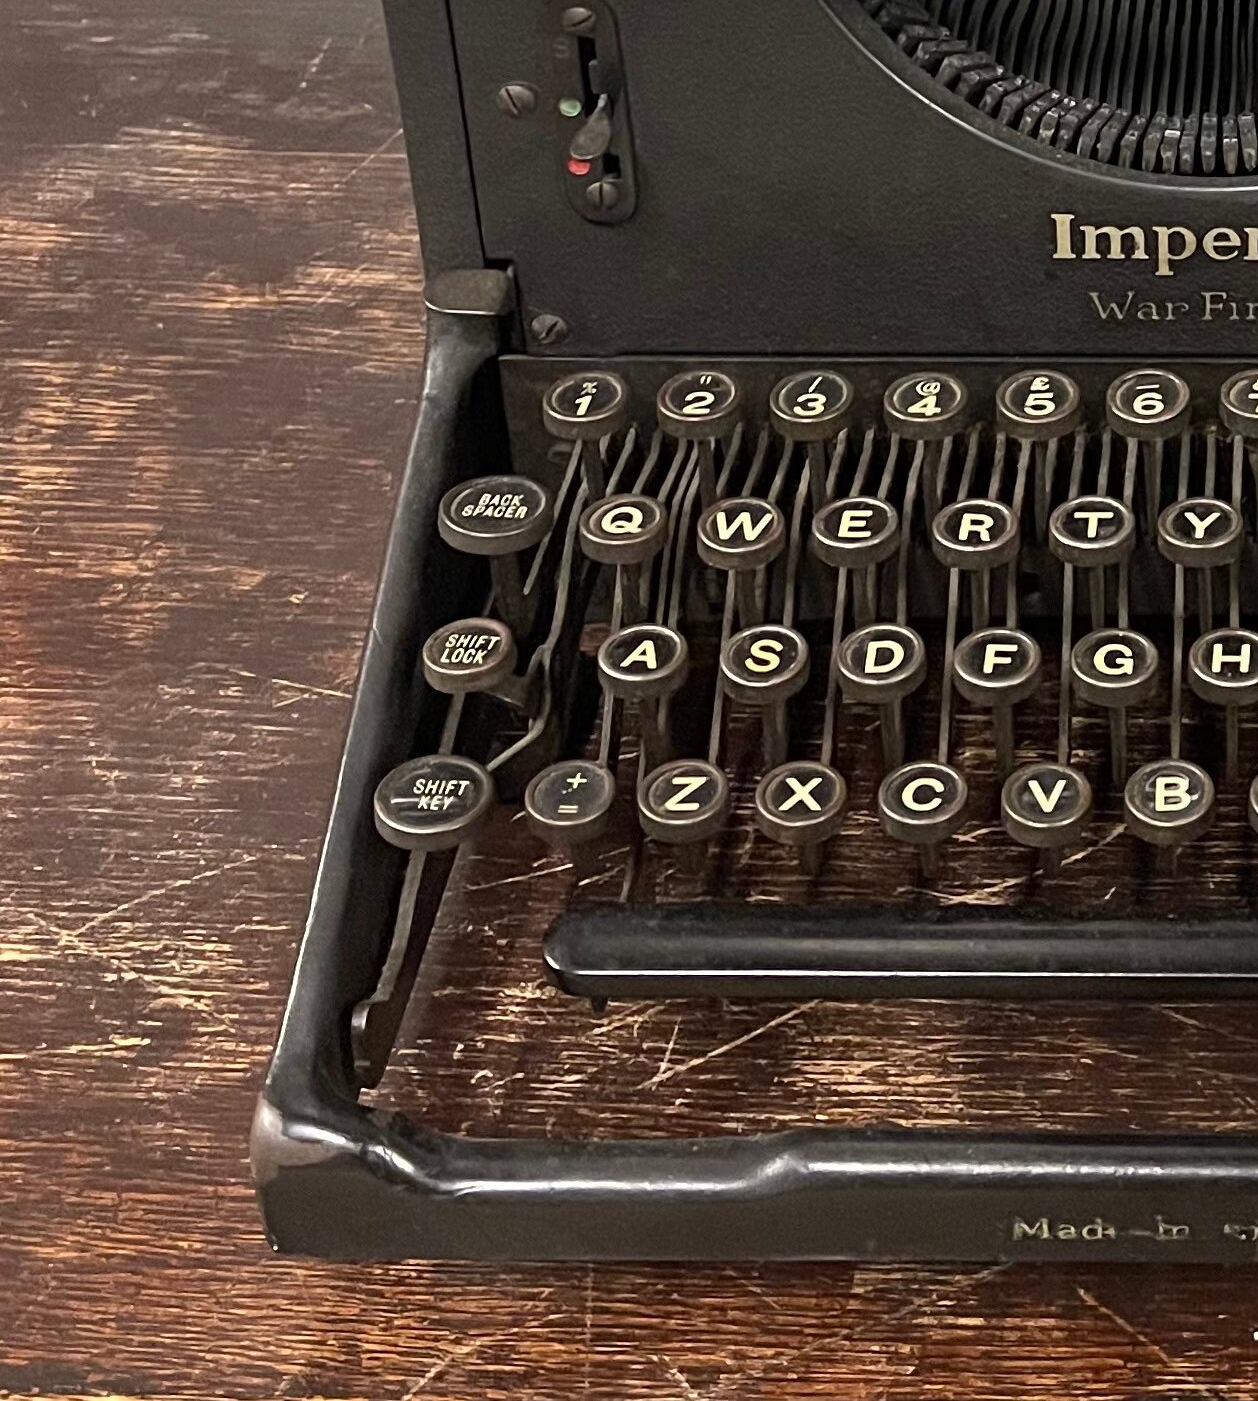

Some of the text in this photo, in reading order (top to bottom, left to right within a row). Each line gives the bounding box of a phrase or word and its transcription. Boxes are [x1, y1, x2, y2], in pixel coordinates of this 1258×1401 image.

[1088, 290, 1189, 321] War
[911, 377, 941, 396] @
[574, 394, 593, 416] 1
[682, 391, 716, 416] 2
[793, 392, 827, 417] 3
[907, 395, 944, 418] 4
[1023, 392, 1056, 416] 5
[1132, 392, 1166, 417] 6
[461, 504, 528, 519] SPACER
[478, 493, 524, 507] BACK
[600, 505, 644, 534] Q
[716, 510, 773, 542] W
[837, 509, 874, 538] E
[958, 512, 993, 542] R
[1073, 511, 1117, 540] T
[1184, 511, 1221, 539] Y
[439, 646, 491, 666] LOCK
[444, 632, 502, 651] SHIFT
[619, 639, 657, 670] A
[744, 639, 784, 673] S
[864, 640, 905, 674] D
[982, 643, 1019, 674] F
[1093, 643, 1134, 676] G
[1211, 643, 1251, 675] H
[412, 778, 471, 799] SHIFT
[413, 794, 457, 811] KEY
[663, 775, 709, 812] Z
[777, 776, 823, 812] X
[901, 777, 945, 812] C
[1027, 779, 1067, 813] V
[1154, 776, 1192, 812] B
